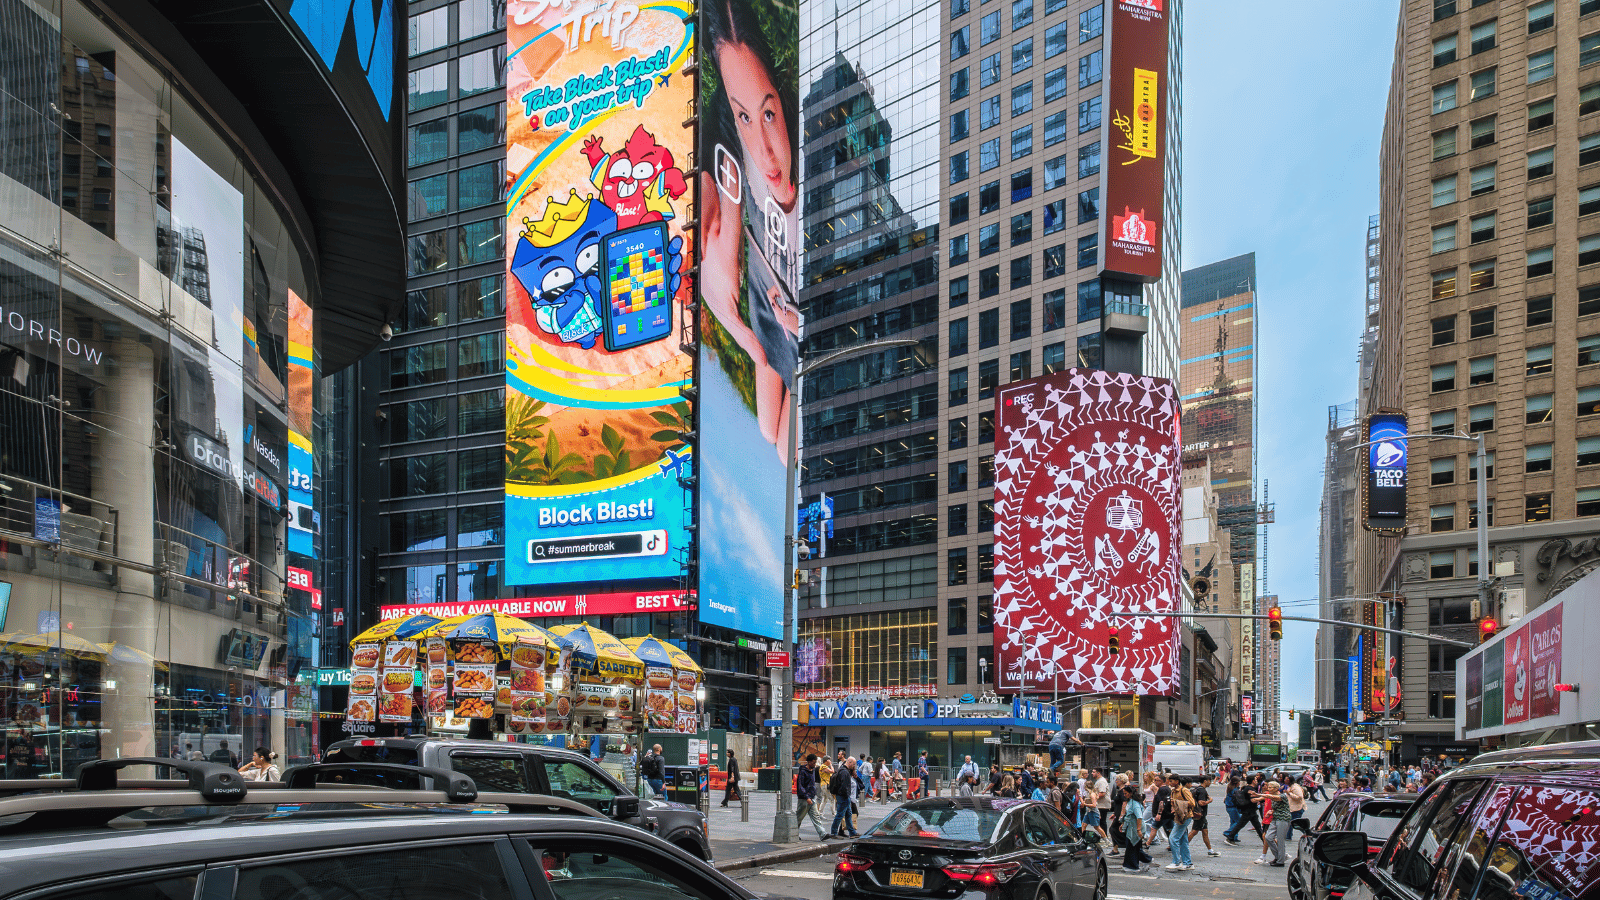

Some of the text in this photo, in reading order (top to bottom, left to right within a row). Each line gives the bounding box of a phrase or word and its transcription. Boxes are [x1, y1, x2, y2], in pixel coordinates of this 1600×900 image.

[1119, 4, 1162, 19] MAHARASHTRA
[561, 5, 640, 52] Trip
[522, 46, 670, 117] Take Block Blast!
[545, 78, 652, 130] on your trip
[1141, 80, 1150, 149] MAHARASHTRA
[616, 203, 641, 215] Blast!
[626, 242, 645, 254] 3540
[1112, 241, 1155, 254] MAHARASHTRA
[0, 306, 102, 366] ORROW
[562, 323, 588, 341] Block
[1013, 393, 1035, 405] REC
[253, 435, 280, 473] Nasdaq
[1374, 469, 1403, 479] TACO
[1376, 478, 1404, 487] BELL
[538, 498, 654, 527] Block Blast!
[547, 542, 615, 555] #summerbreak
[636, 594, 670, 608] BEST
[709, 599, 736, 613] Instagram
[409, 603, 465, 618] SKYWALK
[467, 602, 531, 617] AVAILABLE
[533, 600, 566, 613] NOW
[1242, 570, 1251, 685] HOTE CARTER
[599, 661, 642, 675] SABRETT
[336, 671, 351, 682] Tic
[1006, 671, 1052, 681] Warli Art
[809, 699, 960, 719] NEW YORK POLICE DEPT
[1013, 697, 1026, 719] NEW
[1026, 701, 1039, 720] YORK
[1038, 703, 1051, 723] POLICE
[341, 723, 376, 735] square
